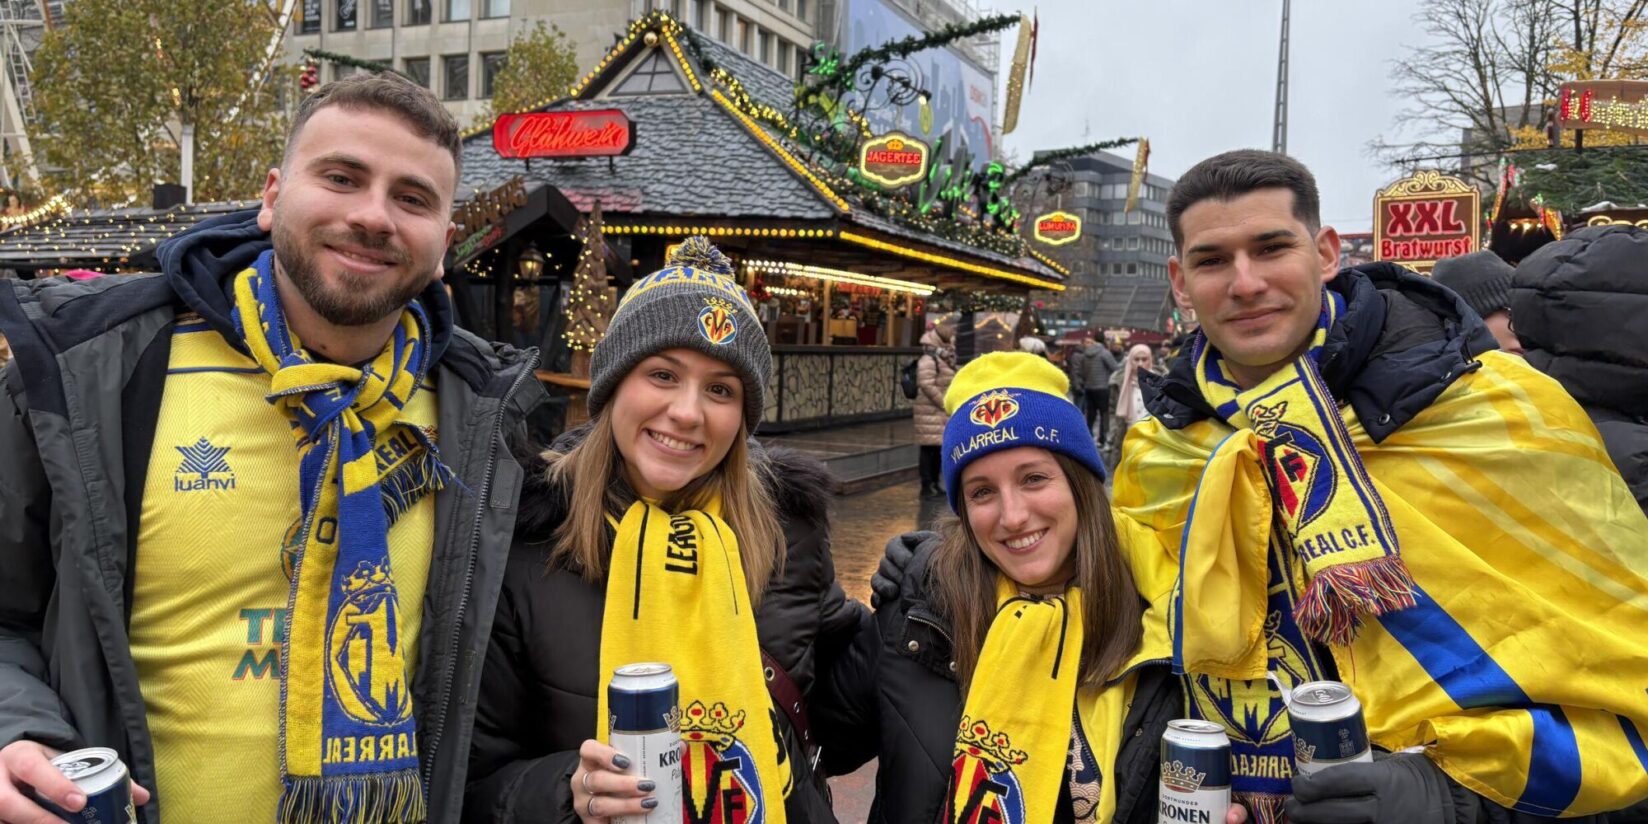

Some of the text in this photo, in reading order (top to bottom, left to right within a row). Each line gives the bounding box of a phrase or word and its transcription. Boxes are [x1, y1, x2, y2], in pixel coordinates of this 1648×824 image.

[1387, 200, 1466, 236] XXL
[1380, 236, 1473, 260] Bratwurst
[950, 426, 1060, 464] VILLARREAL C.F.
[174, 473, 236, 492] luanvi
[1341, 524, 1376, 549] C.F.
